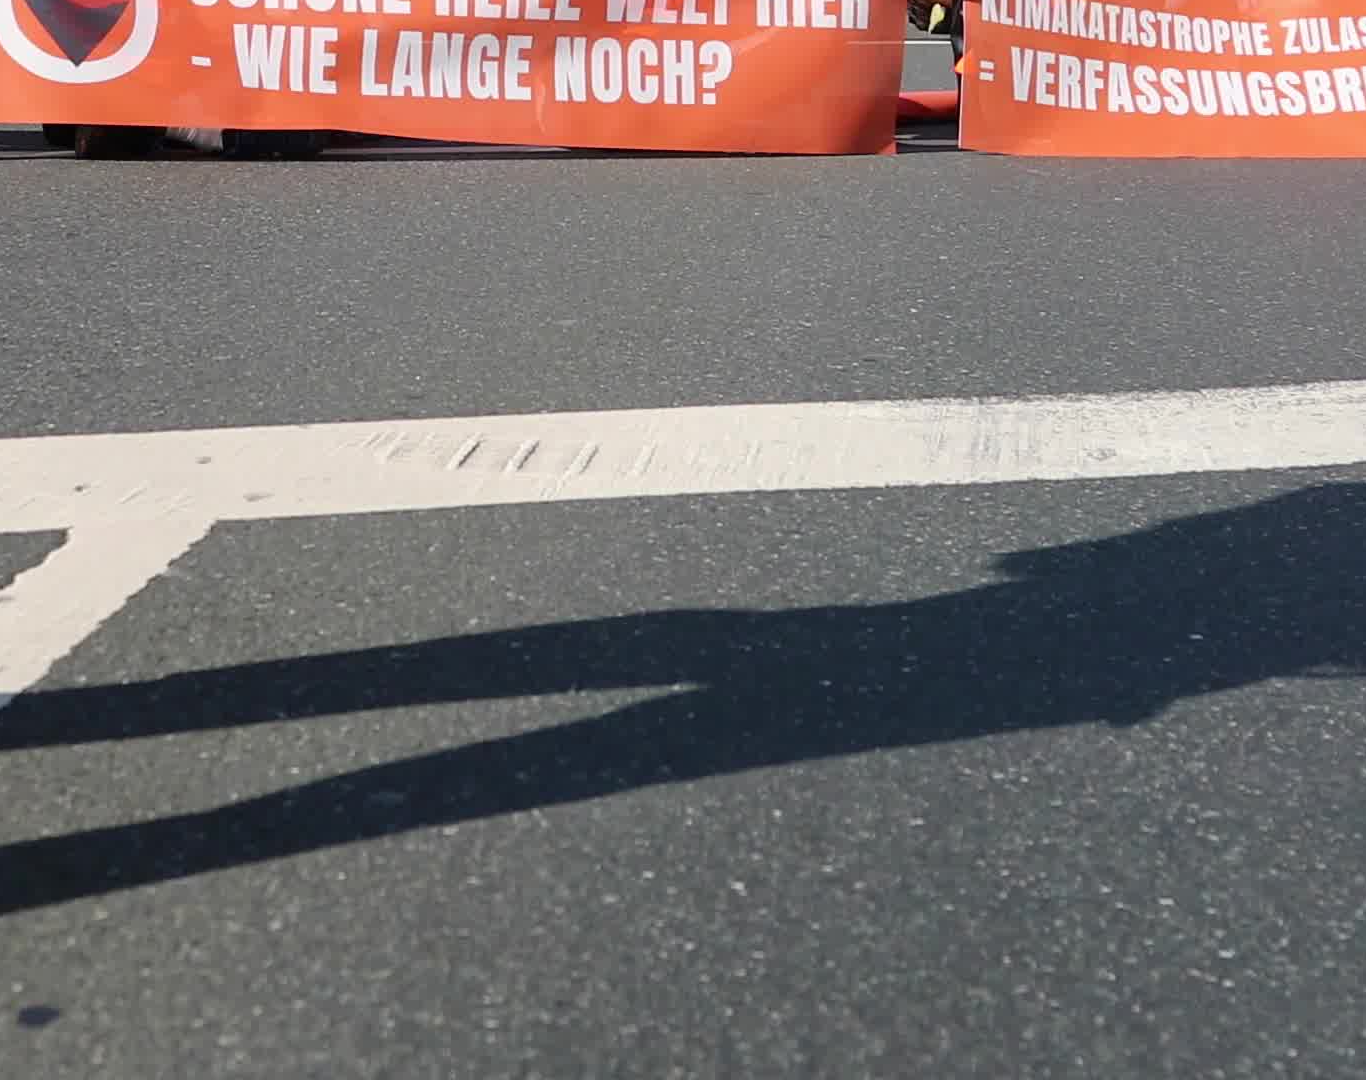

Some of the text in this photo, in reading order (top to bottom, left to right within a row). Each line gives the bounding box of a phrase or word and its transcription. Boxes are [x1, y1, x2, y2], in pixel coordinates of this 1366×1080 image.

[233, 23, 339, 94] WIE
[361, 29, 533, 101] LANGE
[553, 36, 733, 105] NOCH?
